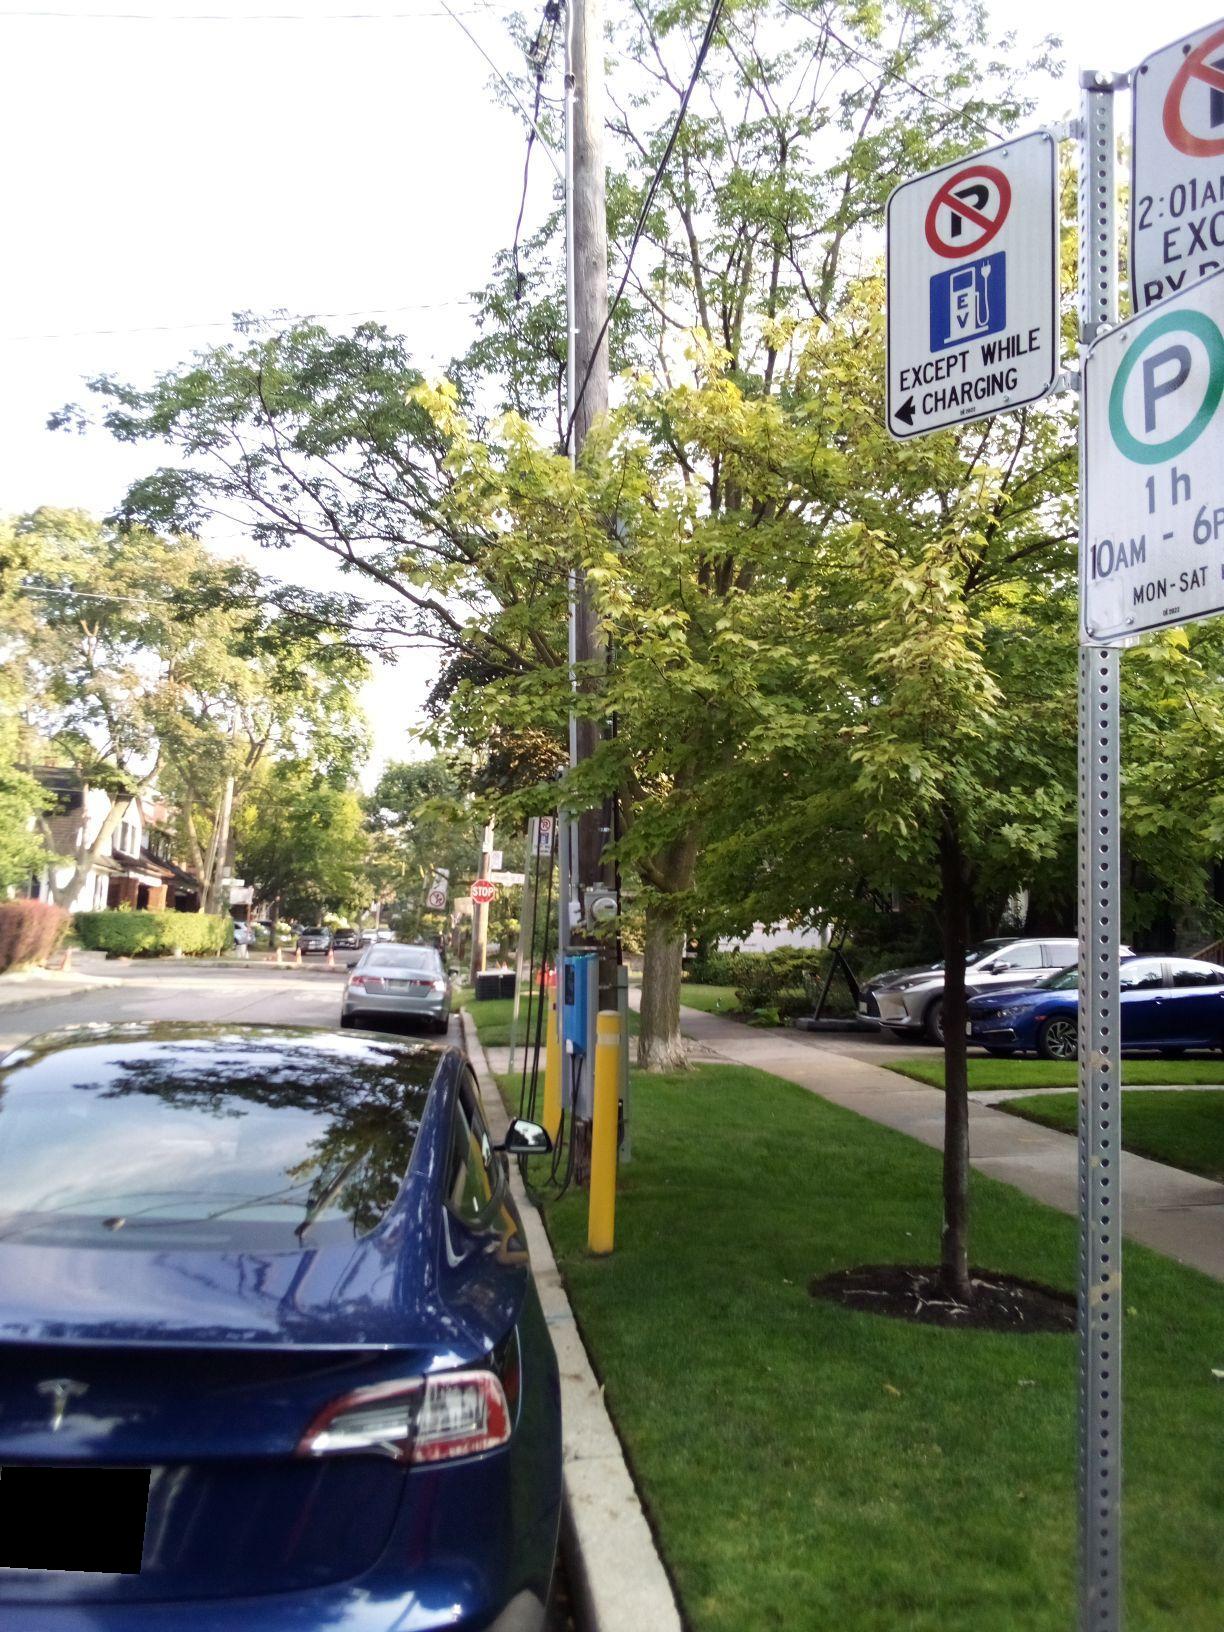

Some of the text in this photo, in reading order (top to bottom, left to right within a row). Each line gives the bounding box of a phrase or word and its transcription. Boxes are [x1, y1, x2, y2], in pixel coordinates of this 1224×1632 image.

[1138, 175, 1224, 231] 2:01A
[1163, 210, 1224, 265] EXC
[900, 327, 1041, 392] EXCEPT WHILE
[922, 367, 1018, 415] CHARGING
[1145, 463, 1191, 514] 1 h
[1090, 534, 1146, 580] 10AM
[472, 886, 494, 897] STOP
